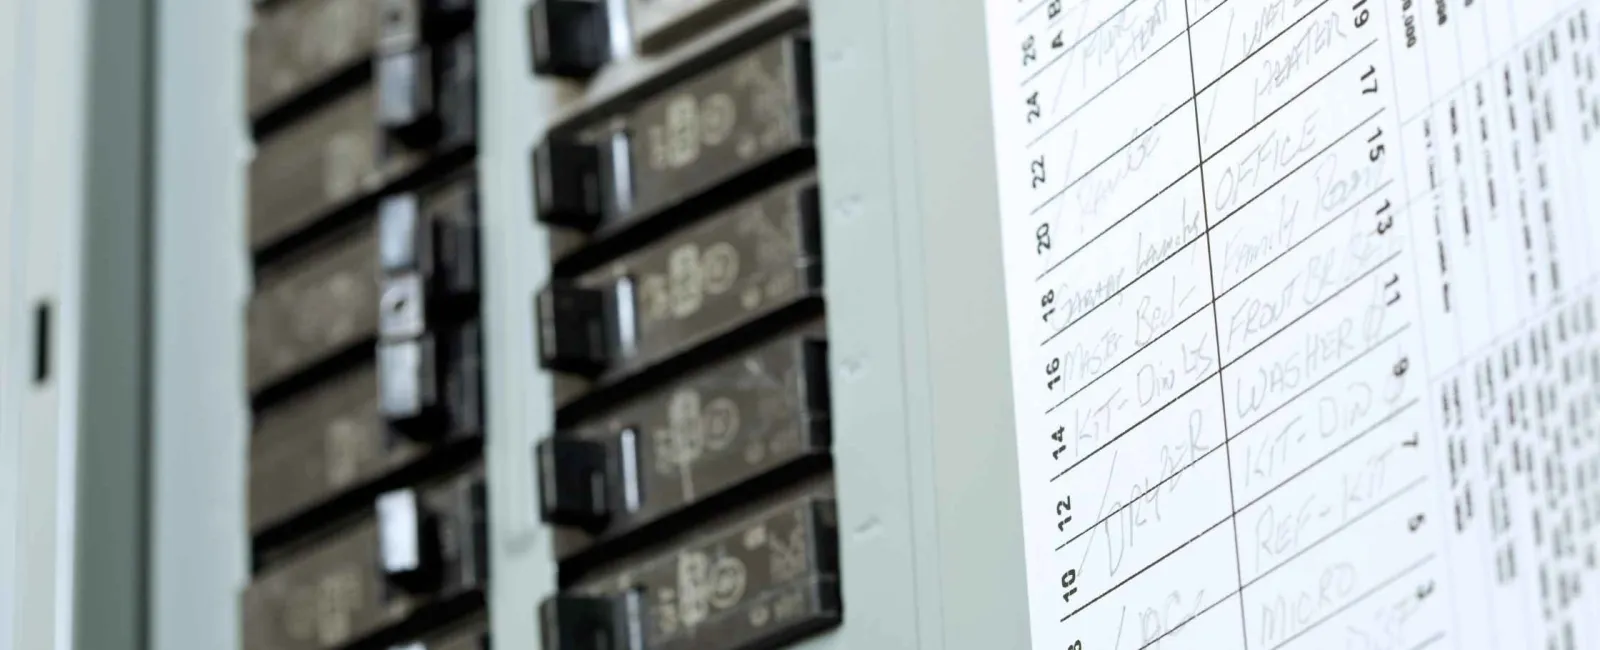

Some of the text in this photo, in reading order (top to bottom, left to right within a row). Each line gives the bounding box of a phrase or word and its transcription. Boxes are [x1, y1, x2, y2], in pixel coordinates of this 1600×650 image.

[1352, 0, 1370, 29] 19
[1022, 34, 1037, 66] 26
[1360, 65, 1379, 96] 17
[1026, 91, 1042, 124] 24
[1215, 109, 1320, 212] OFFICE
[1366, 126, 1387, 163] 15
[1030, 154, 1046, 189] 22
[1374, 198, 1394, 237] 13
[1035, 221, 1052, 256] 20
[1040, 287, 1057, 323] 18
[1384, 272, 1403, 308] 11
[1045, 356, 1062, 392] 16
[1236, 316, 1356, 419] WASHER
[1392, 356, 1410, 379] 9
[1050, 424, 1067, 461] 14
[1401, 430, 1419, 448] 7
[1056, 494, 1073, 533] 12
[1060, 567, 1078, 604] 10
